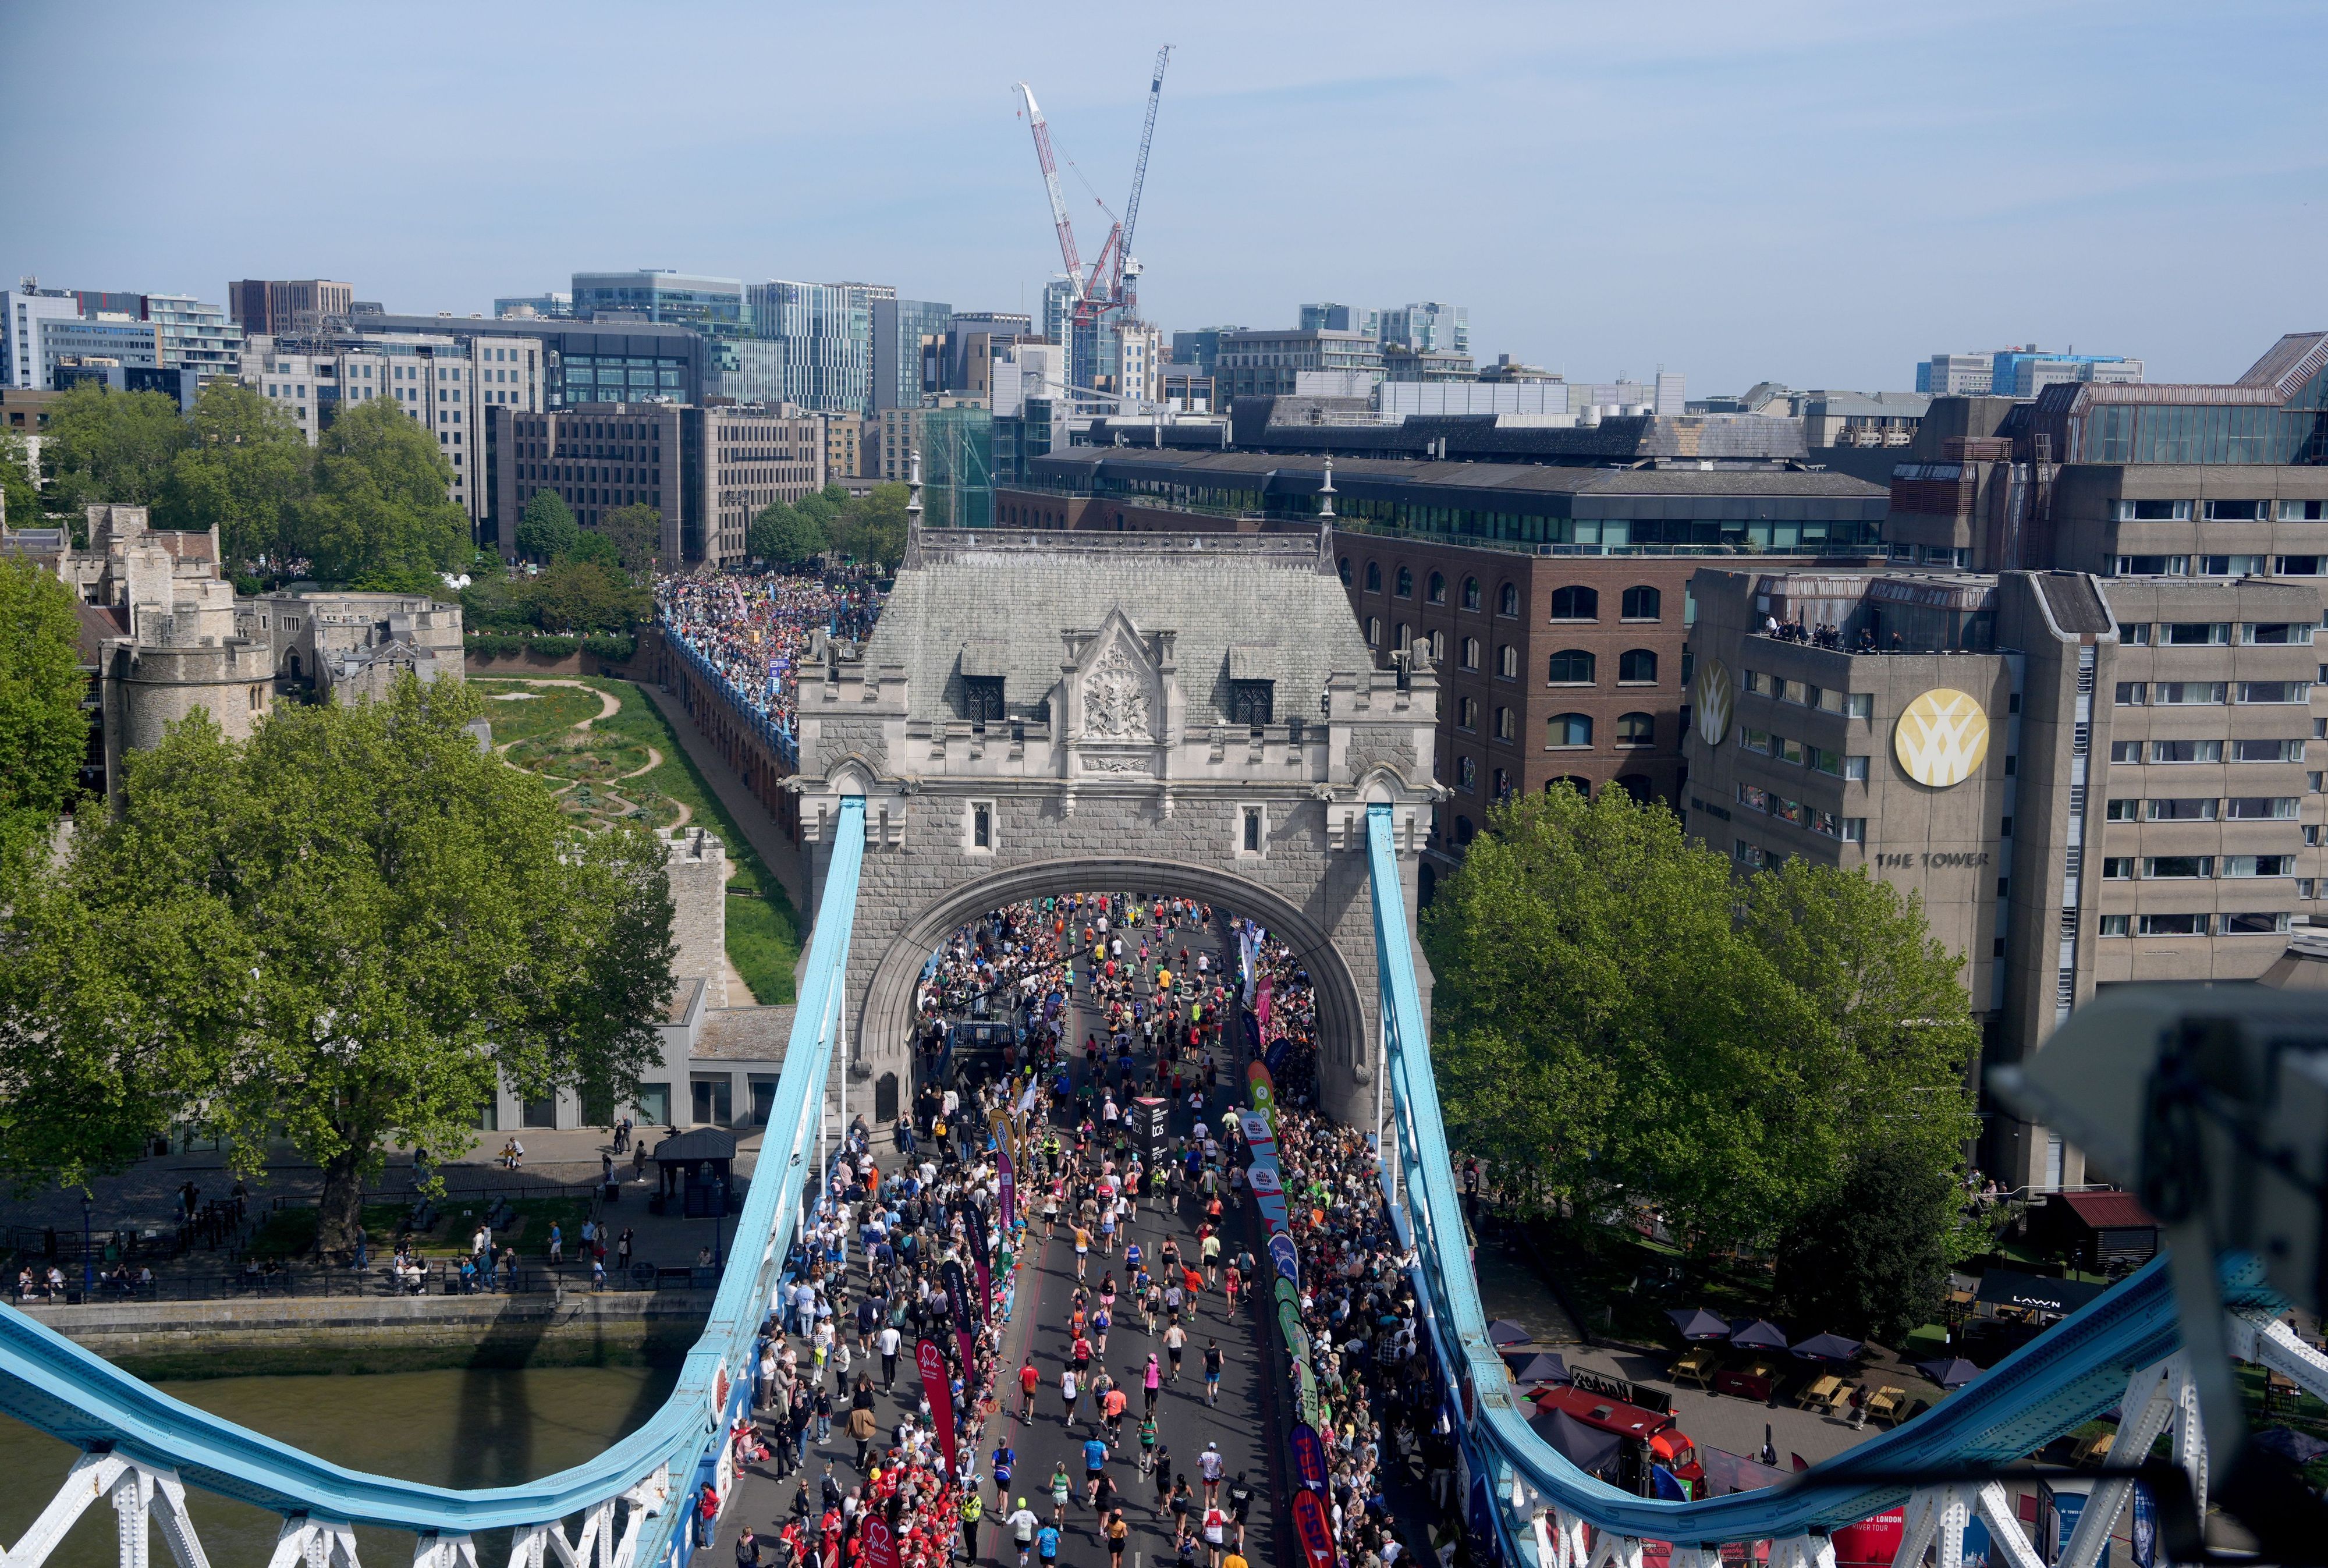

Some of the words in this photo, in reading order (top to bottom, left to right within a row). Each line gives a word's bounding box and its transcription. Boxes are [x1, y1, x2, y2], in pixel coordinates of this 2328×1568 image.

[1876, 852, 1914, 868] THE
[1922, 852, 1989, 868] TOWER
[1152, 1109, 1169, 1119] CONSULTANCY
[1133, 1119, 1142, 1135] tcs
[1152, 1124, 1164, 1138] tcs
[970, 1211, 983, 1251] EPILEPSY
[951, 1272, 964, 1316] EPILEPSY
[2013, 1296, 2060, 1308] LAWN
[870, 1555, 887, 1565] Foundation
